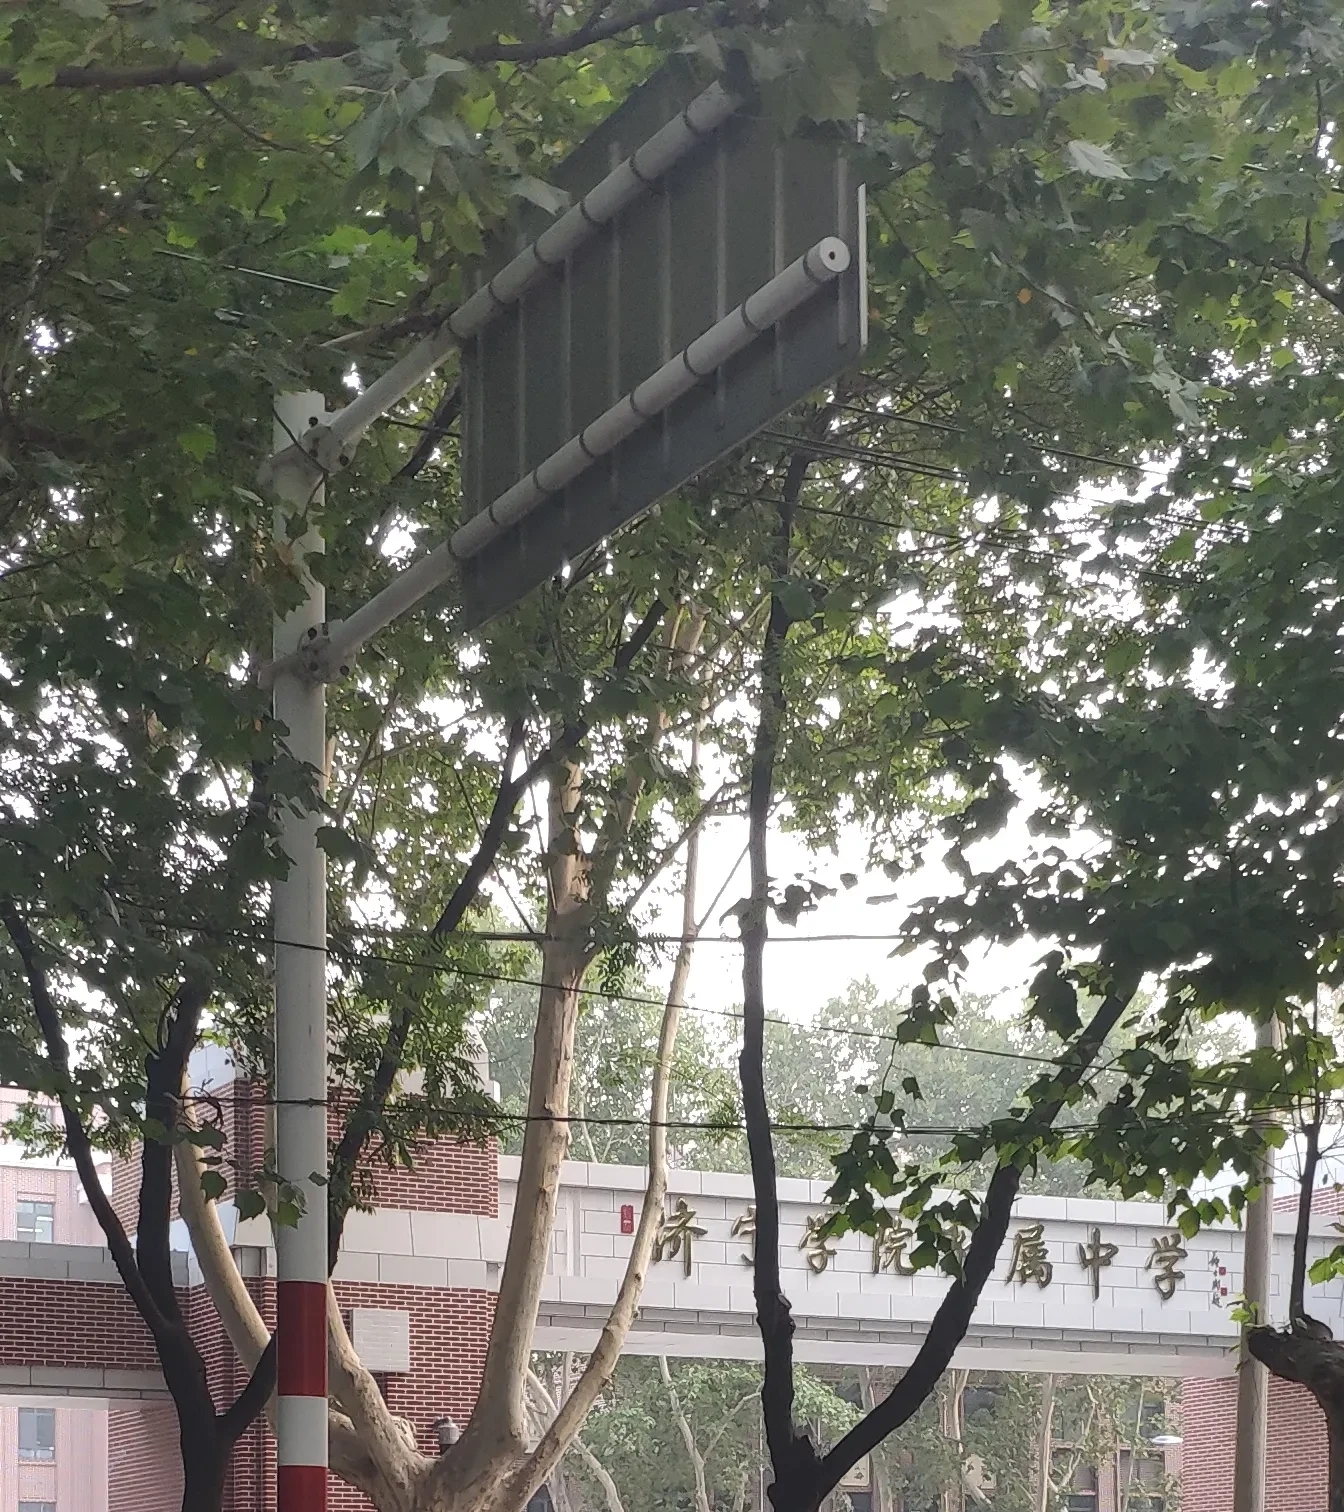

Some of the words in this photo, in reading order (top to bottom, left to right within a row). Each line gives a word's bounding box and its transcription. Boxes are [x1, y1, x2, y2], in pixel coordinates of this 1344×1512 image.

[651, 1197, 1187, 1301] 济学院属中学
